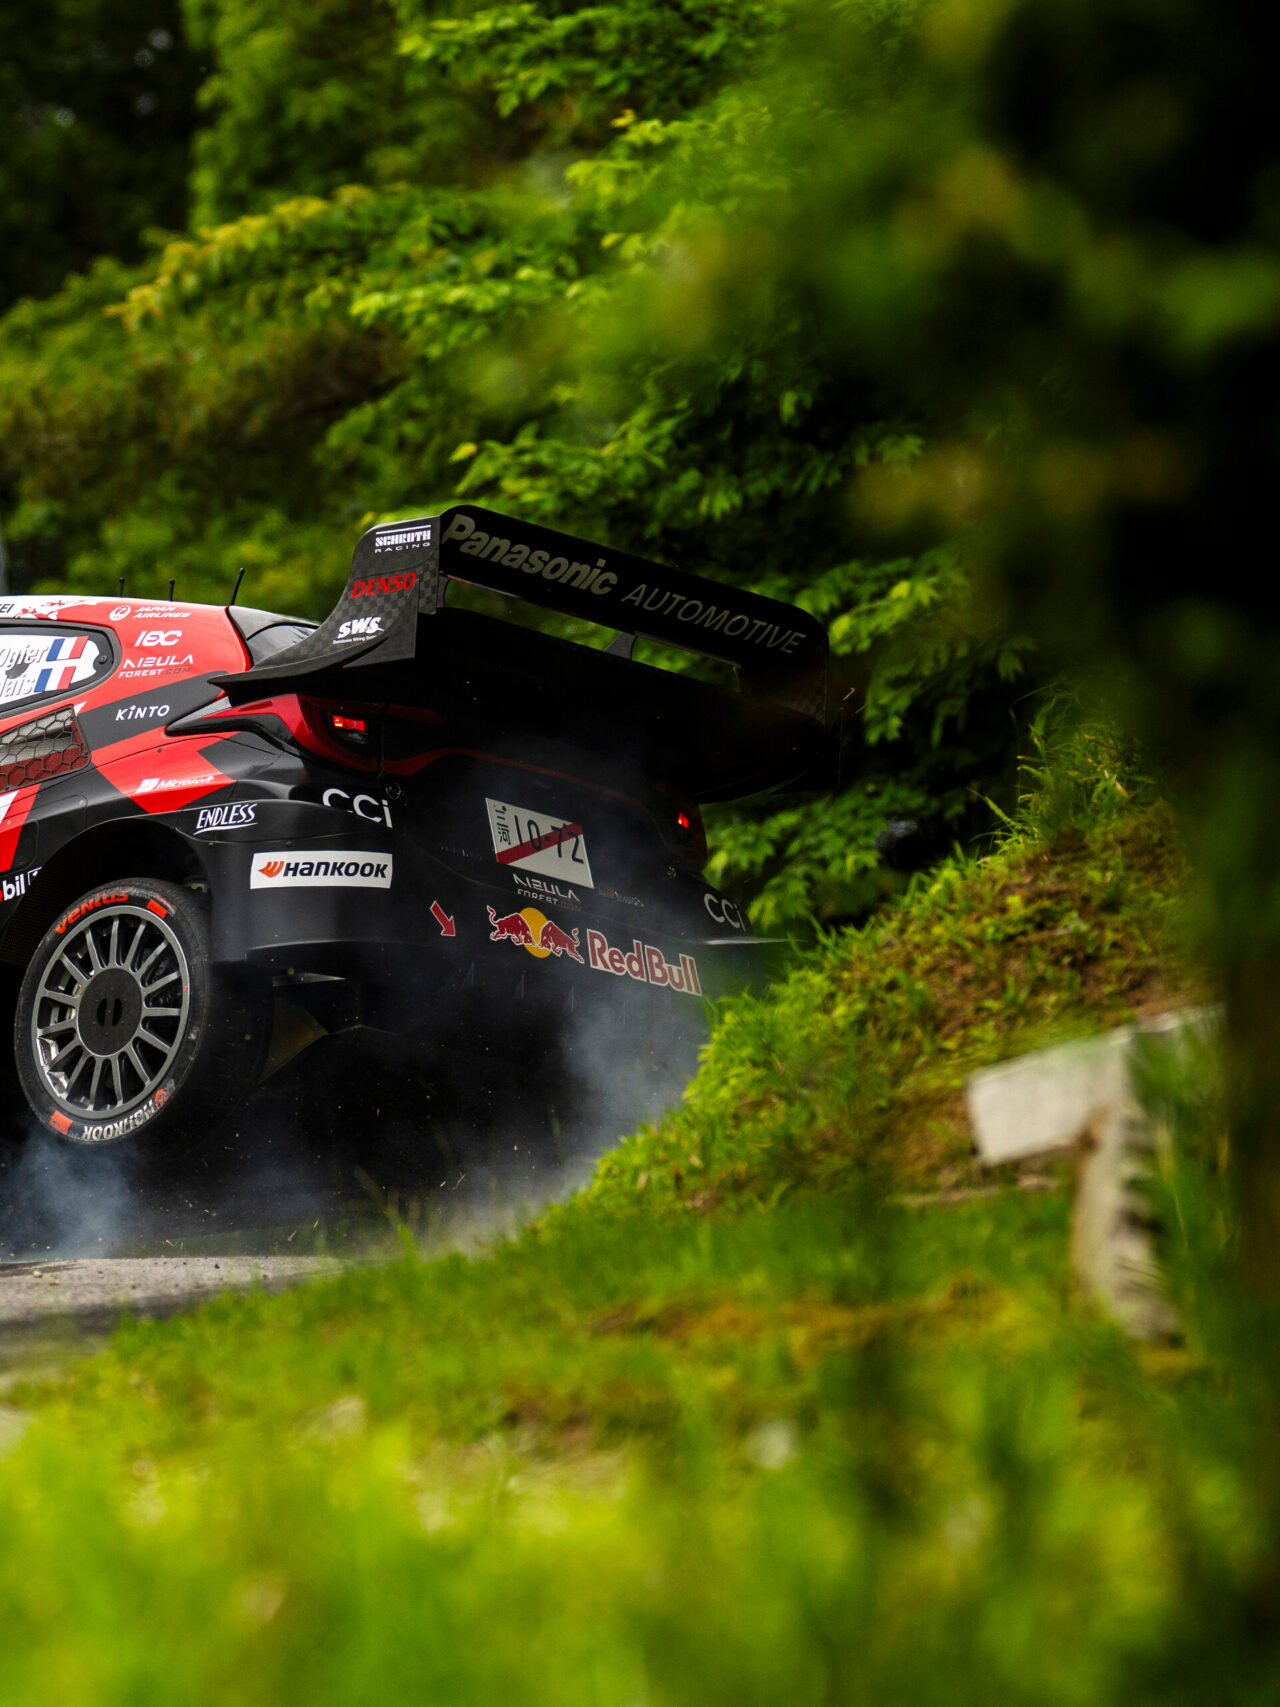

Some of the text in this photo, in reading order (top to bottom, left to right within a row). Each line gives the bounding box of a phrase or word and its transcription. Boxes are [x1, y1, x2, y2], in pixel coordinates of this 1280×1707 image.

[375, 529, 431, 548] SCHROTH
[375, 541, 431, 554] RACING
[351, 572, 417, 598] DENSO
[442, 513, 807, 654] Panasonic AUTOMOTIVE
[337, 616, 384, 639] SWS
[156, 775, 215, 790] Microsoft
[196, 803, 258, 830] ENDLESS
[586, 928, 702, 997] Red Bull
